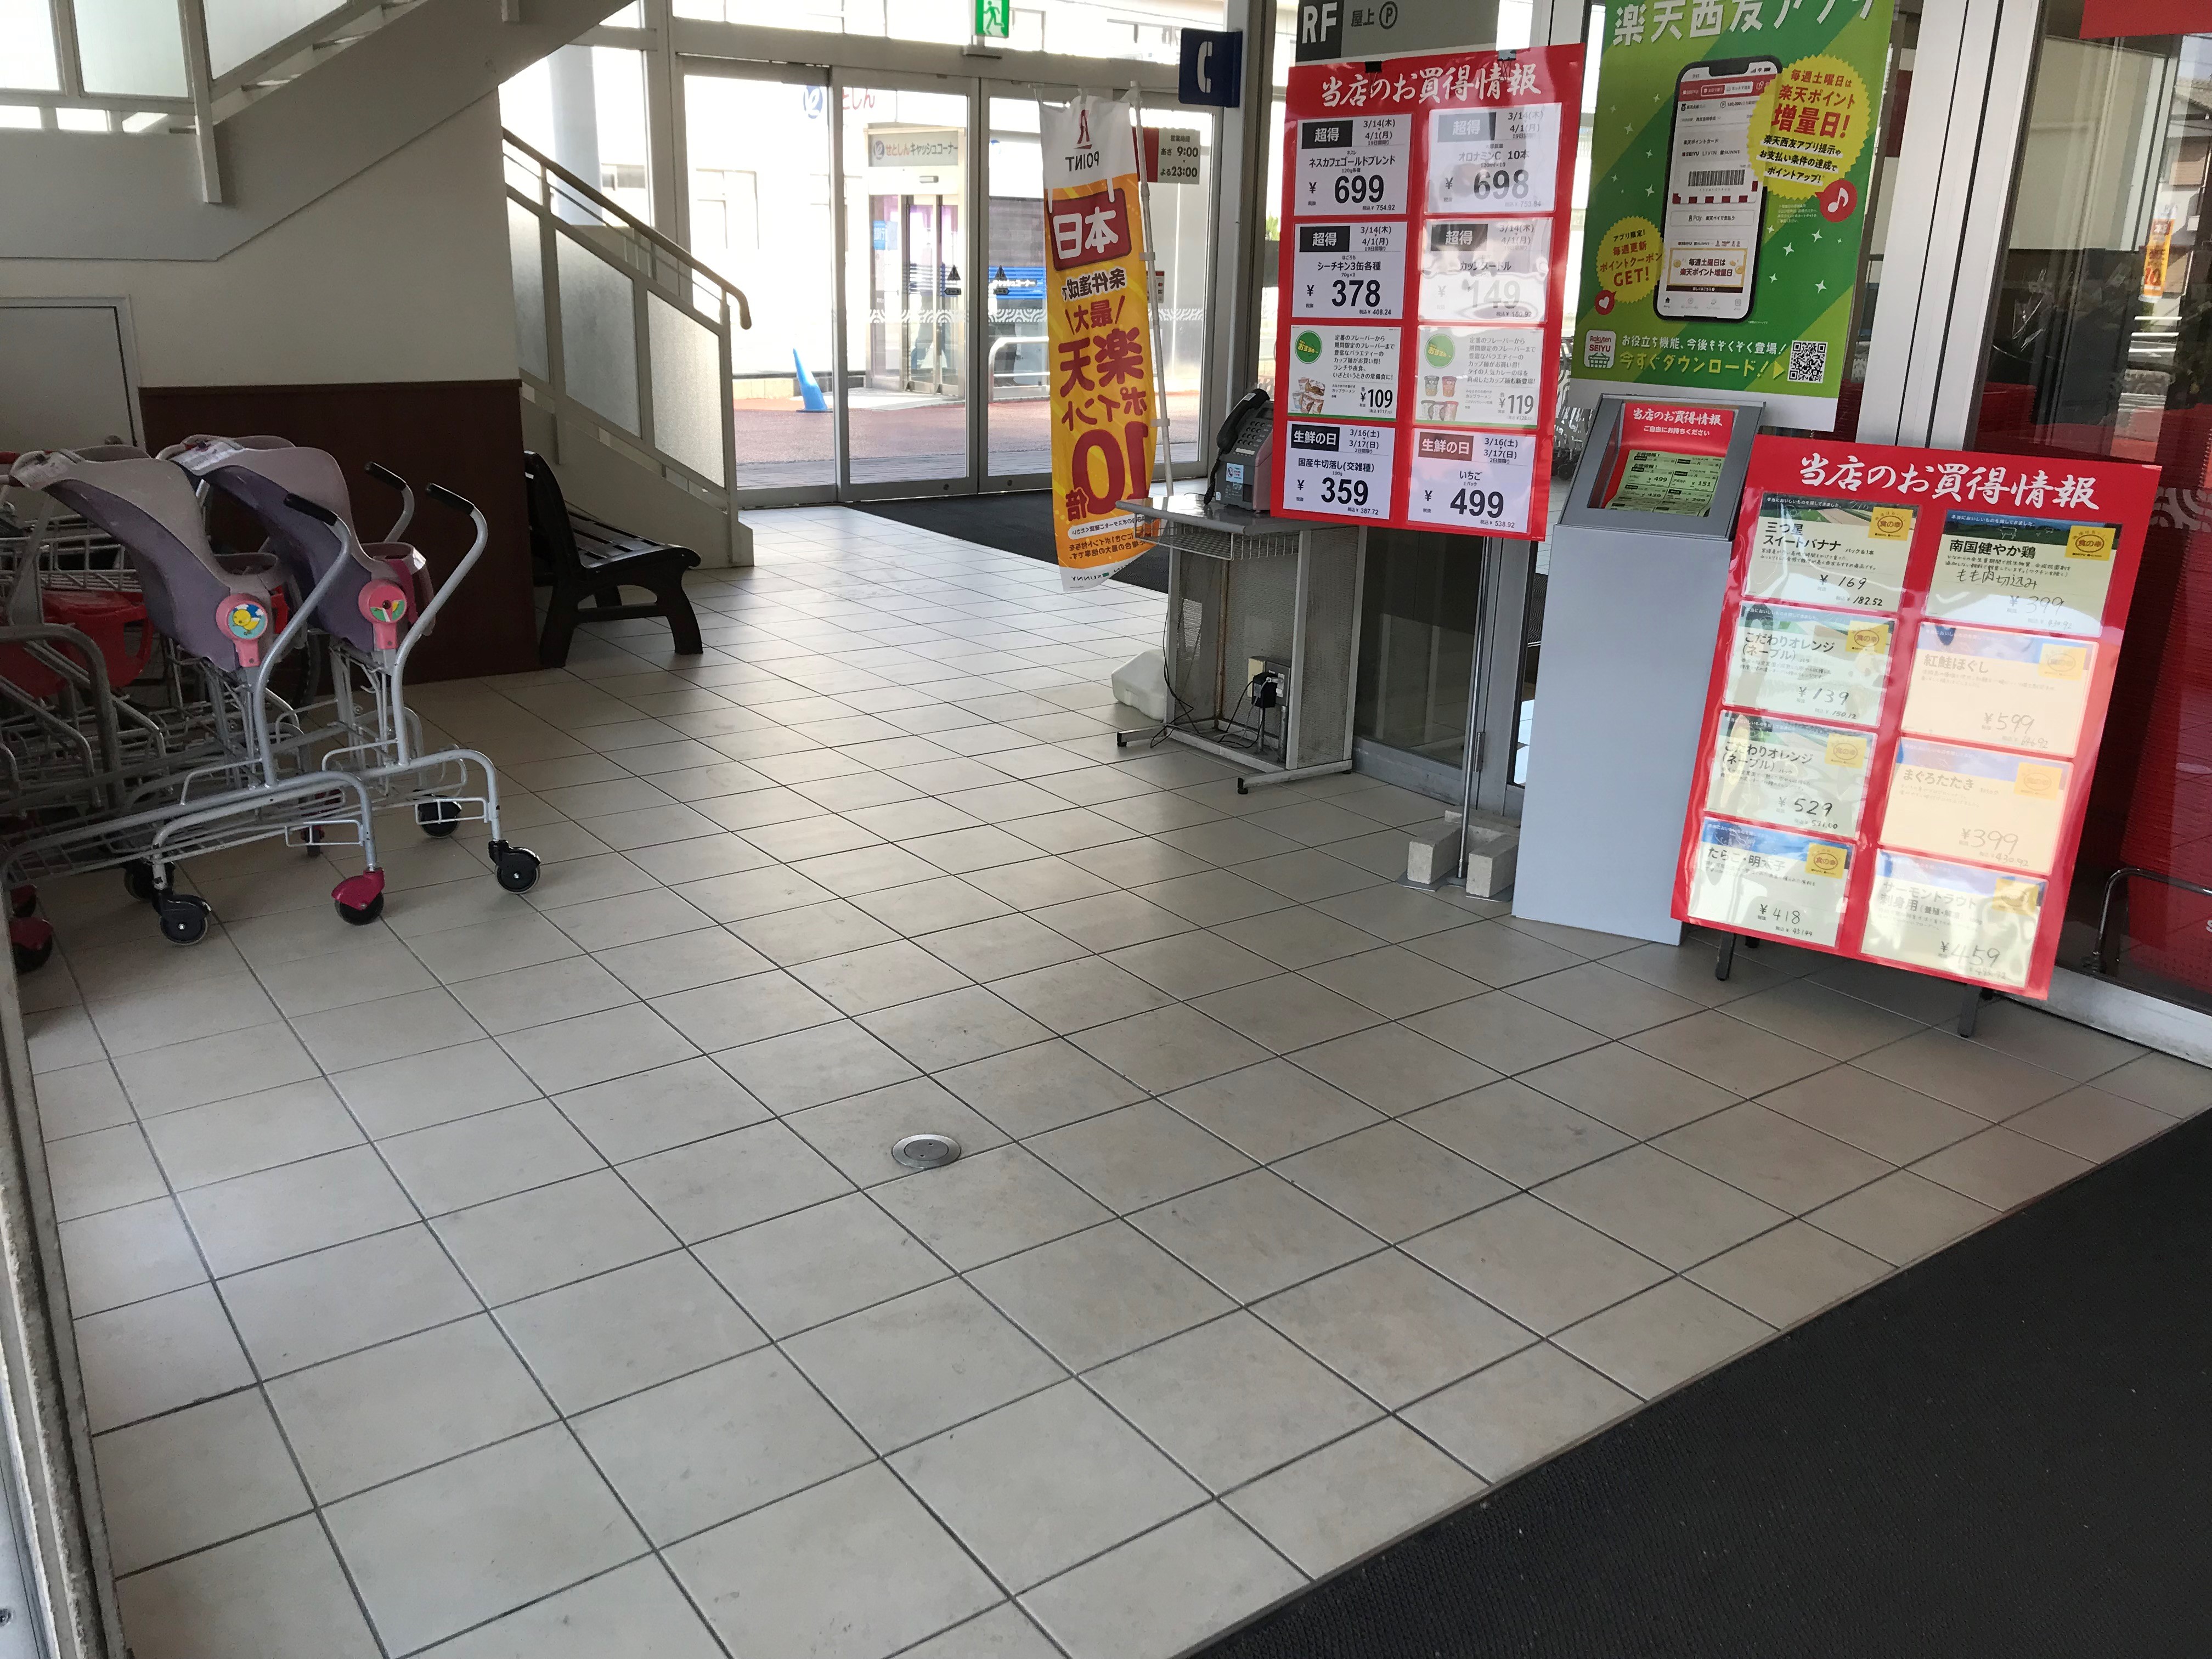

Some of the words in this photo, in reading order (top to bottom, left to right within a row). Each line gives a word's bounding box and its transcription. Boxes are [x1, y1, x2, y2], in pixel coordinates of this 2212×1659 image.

[1302, 2, 1337, 43] RF
[1351, 8, 1374, 27] 屋上
[1321, 63, 1541, 108] 当店のお買得情報
[1791, 69, 1852, 87] 毎週土曜日は
[1779, 84, 1854, 109] 楽天ポイント
[1363, 119, 1396, 128] 3/14(木)
[1452, 120, 1480, 135] 超得
[1771, 103, 1850, 138] 増量日!
[1314, 127, 1339, 142] 超得
[1365, 131, 1392, 140] 4/1(月)
[1177, 146, 1198, 157] 9:00
[1764, 134, 1841, 156] 楽天西友アプリ提示や
[1309, 155, 1396, 168] ネスカフェゴールドブレンド
[1458, 151, 1501, 161] オロナミンC
[1508, 149, 1529, 160] 10本
[1759, 150, 1838, 171] お支払い条件の達成で
[1171, 166, 1197, 177] 23:00
[1768, 167, 1821, 183] ポイントアップ!
[1309, 182, 1317, 193] ¥
[1335, 174, 1384, 204] 699
[1445, 177, 1453, 189] ¥
[1474, 170, 1529, 200] 698
[1361, 226, 1391, 234] 3/14(木)
[1499, 224, 1534, 233] 3/14(木)
[1312, 233, 1337, 246] 超得
[1445, 230, 1472, 245] 超得
[1613, 241, 1646, 256] 毎週更新
[1318, 262, 1381, 271] シーチキン3缶各種
[1600, 253, 1662, 272] ポイントクーポン
[1613, 267, 1649, 286] GET!
[1307, 285, 1314, 296] ¥
[1331, 280, 1380, 307] 378
[1438, 285, 1446, 297] ¥
[1468, 280, 1520, 308] 149
[1633, 409, 1722, 426] 当店のお買得情報
[1294, 431, 1336, 445] 生鮮の日
[1350, 430, 1379, 438] 3/16(土)
[1644, 425, 1709, 436] ご自由にお持ちください
[1349, 441, 1379, 449] 3/17(日)
[1421, 439, 1469, 454] 生鮮の日
[1485, 438, 1518, 448] 3/16(土)
[1484, 450, 1517, 459] 3/17(日)
[1299, 458, 1374, 472] 国産牛切落し(交雑種)
[1459, 471, 1482, 481] いちご
[1799, 453, 2100, 510] 当店のお買得情報
[1297, 479, 1304, 490] ¥
[1321, 477, 1368, 505] 359
[1425, 490, 1432, 501] ¥
[1450, 488, 1504, 518] 499
[1765, 522, 1803, 535] 三つ星
[1763, 535, 1841, 551] スイートバナナ
[1949, 539, 2036, 559] 南国健やか鶏
[1820, 575, 1828, 585] ¥
[1838, 576, 1866, 589] 169
[1853, 596, 1882, 606] 182.52
[2026, 596, 2064, 614] 399
[1745, 632, 1835, 652] こだわりオレンジ
[1923, 654, 1989, 674] 紅鮭ほぐし
[1798, 687, 1807, 697] ¥
[1813, 688, 1849, 706] 139
[1996, 713, 2035, 734] 599
[1903, 769, 1974, 791] まぐろたたき
[1794, 798, 1832, 817] 529
[1971, 830, 2018, 855] 399
[1760, 904, 1768, 915] ¥
[1773, 908, 1801, 924] 418
[1951, 944, 2000, 967] 459
